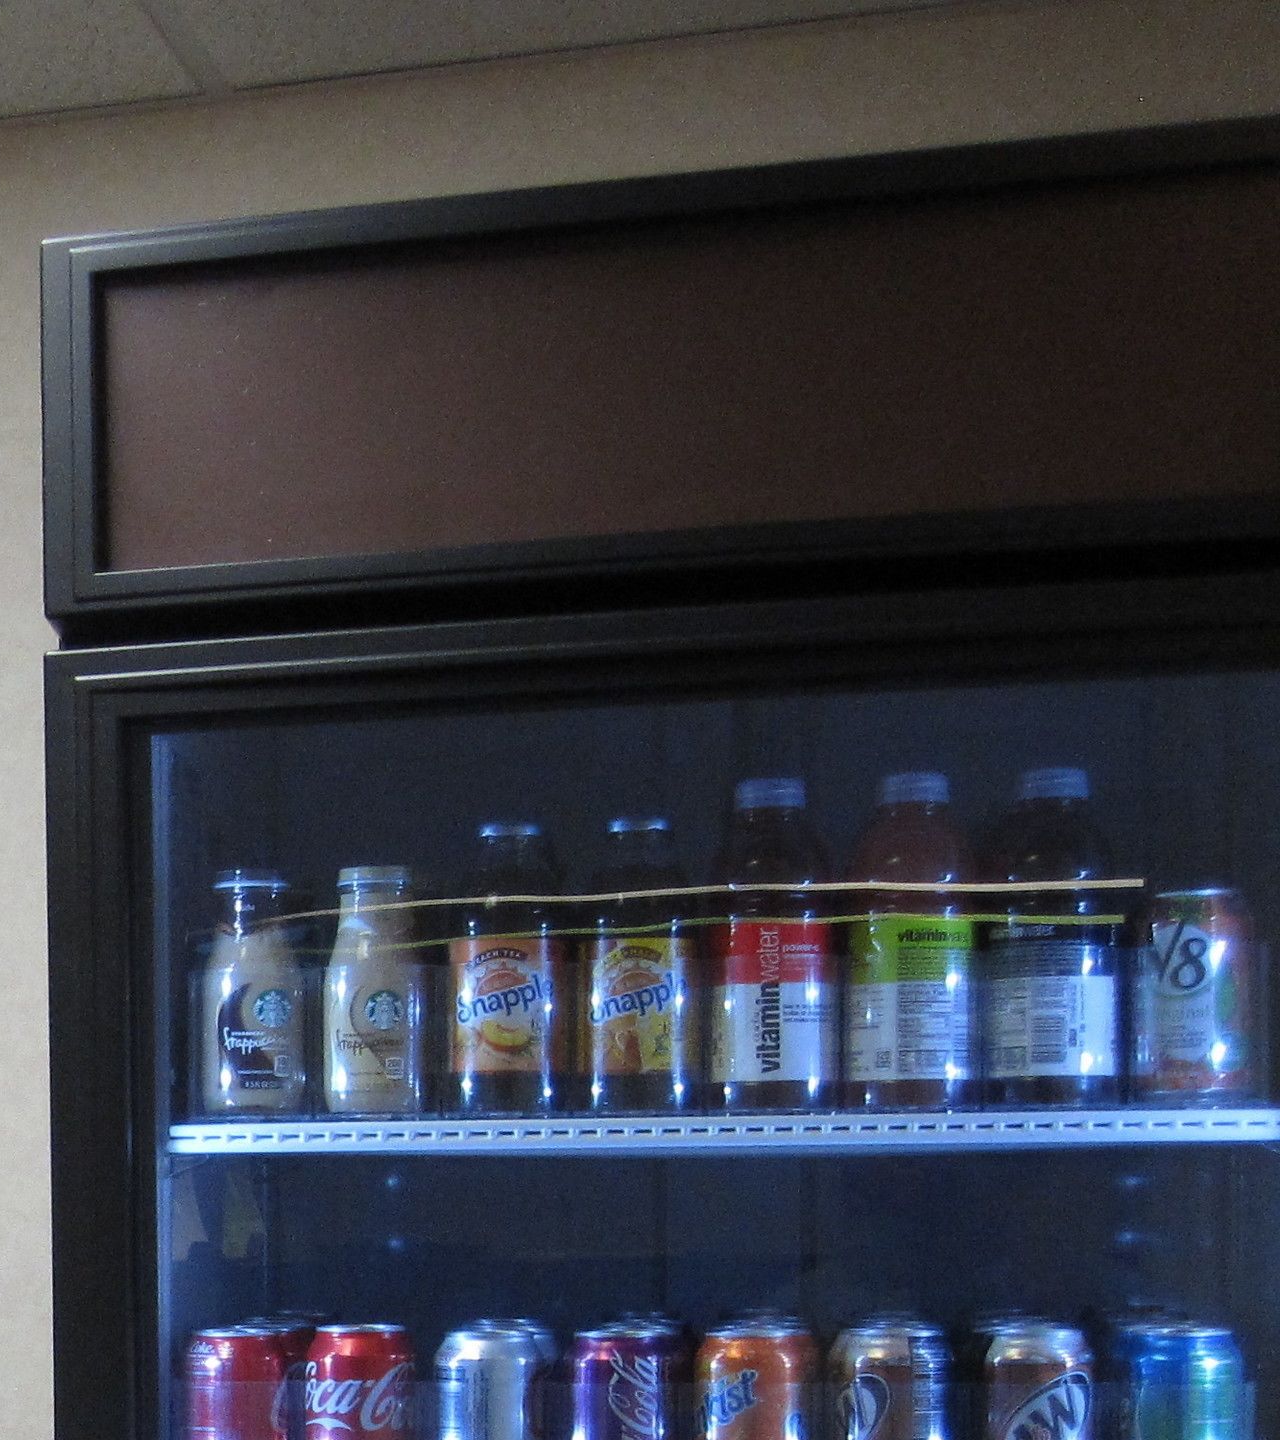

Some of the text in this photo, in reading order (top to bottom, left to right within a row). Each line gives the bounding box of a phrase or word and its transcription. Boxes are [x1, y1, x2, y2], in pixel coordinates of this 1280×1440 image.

[1152, 921, 1208, 991] V8
[457, 972, 554, 1025] Snapple
[590, 970, 688, 1025] Snapple
[755, 926, 781, 1074] vitaminwater
